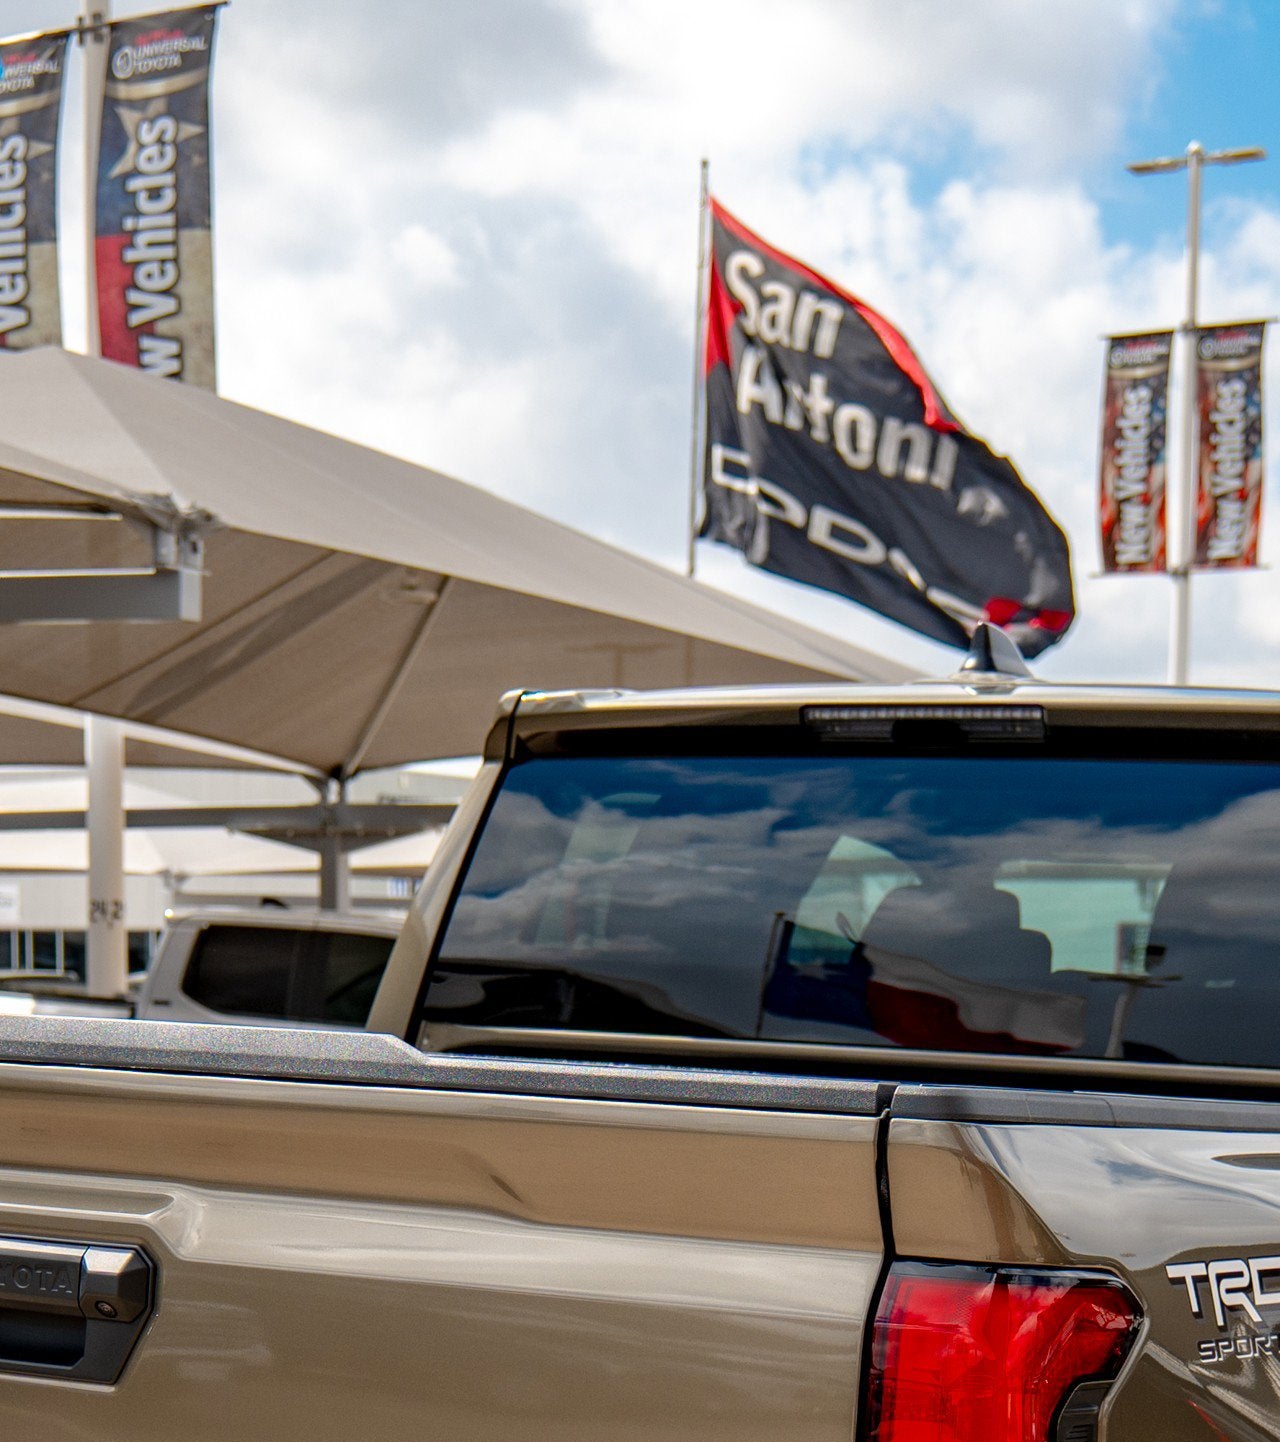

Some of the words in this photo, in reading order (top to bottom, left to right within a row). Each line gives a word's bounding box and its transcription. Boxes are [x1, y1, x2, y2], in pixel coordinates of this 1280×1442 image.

[122, 115, 180, 329] Vehicles
[724, 249, 844, 359] San
[1113, 384, 1152, 500] Vehicles
[1208, 378, 1248, 499] Vehicles
